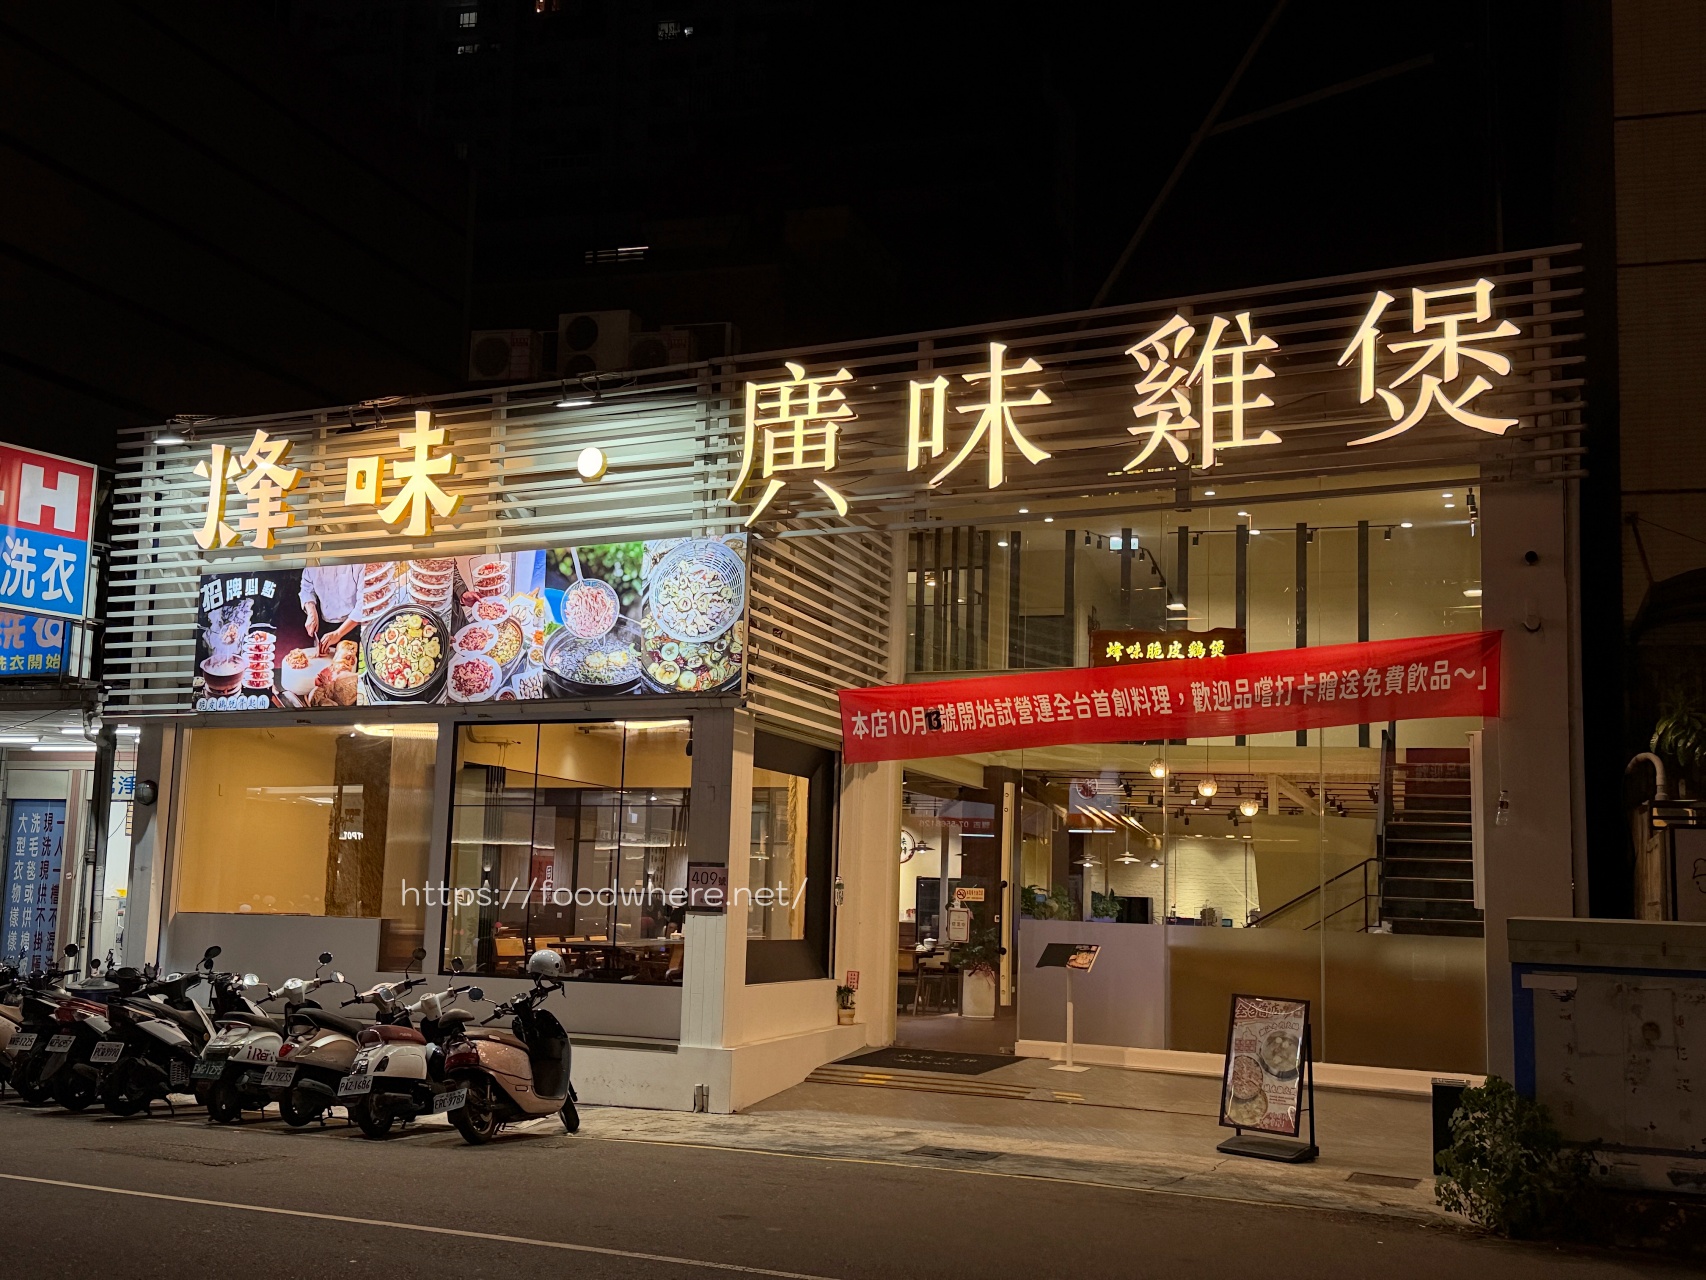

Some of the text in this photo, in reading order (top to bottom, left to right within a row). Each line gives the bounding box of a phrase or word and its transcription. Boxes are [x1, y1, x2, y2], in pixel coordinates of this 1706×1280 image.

[728, 278, 1522, 527] 廣味雞煲
[200, 577, 277, 612] 招牌必點
